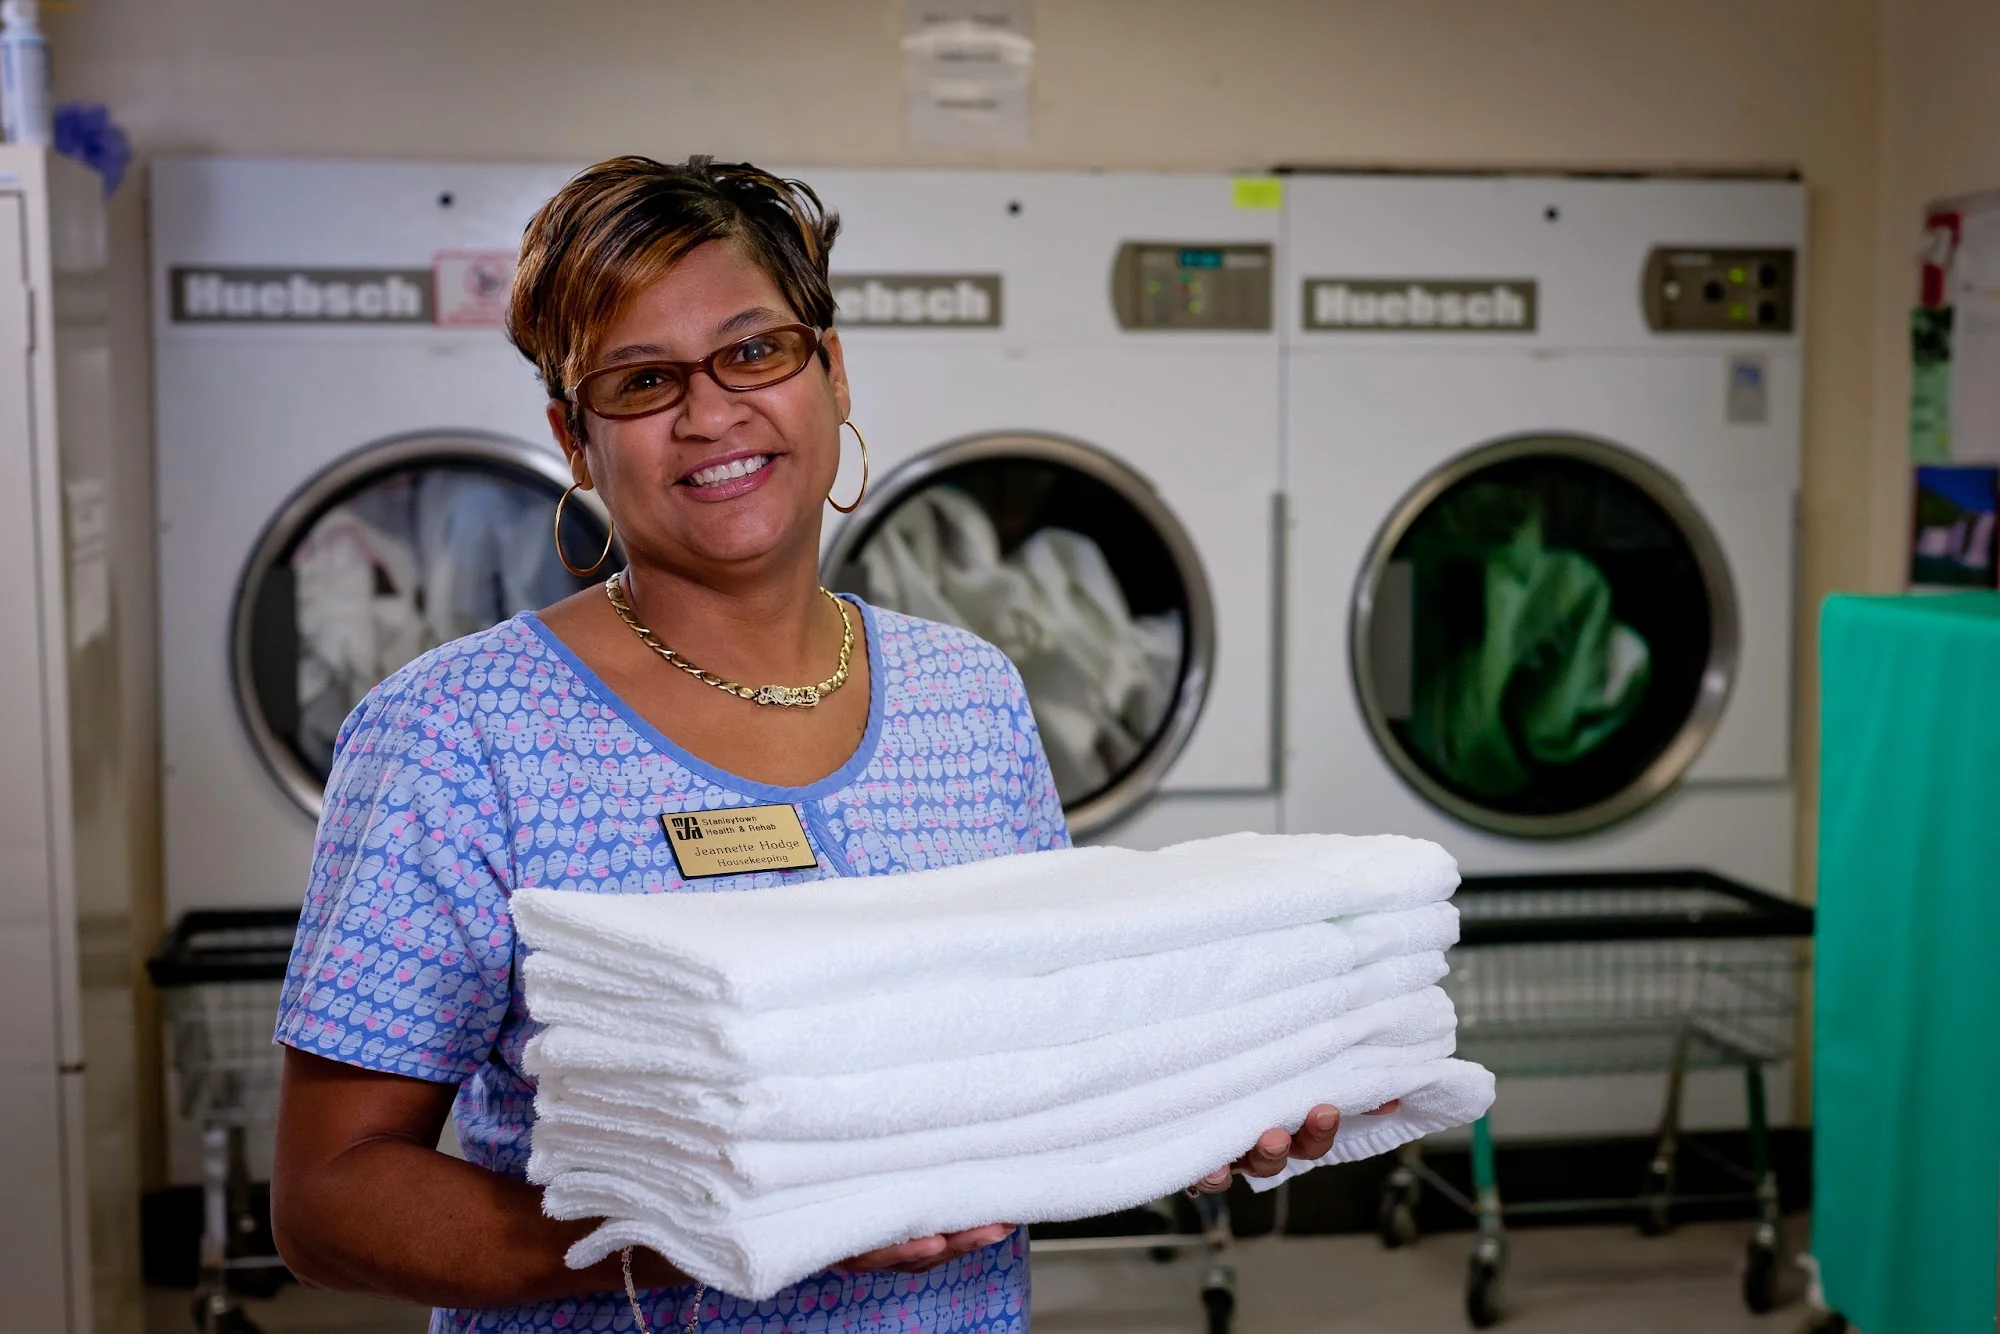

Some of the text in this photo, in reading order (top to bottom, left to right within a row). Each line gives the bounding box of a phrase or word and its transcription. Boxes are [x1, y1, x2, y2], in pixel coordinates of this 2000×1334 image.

[184, 273, 421, 317] Huebsch
[835, 281, 990, 322] ebsch
[1314, 285, 1525, 326] Huebsch
[702, 815, 758, 826] Stanleytown
[706, 825, 735, 835] Health
[748, 823, 776, 833] Rehab
[694, 839, 800, 856] Jeannette Hodge
[717, 854, 789, 867] Housekeeping
